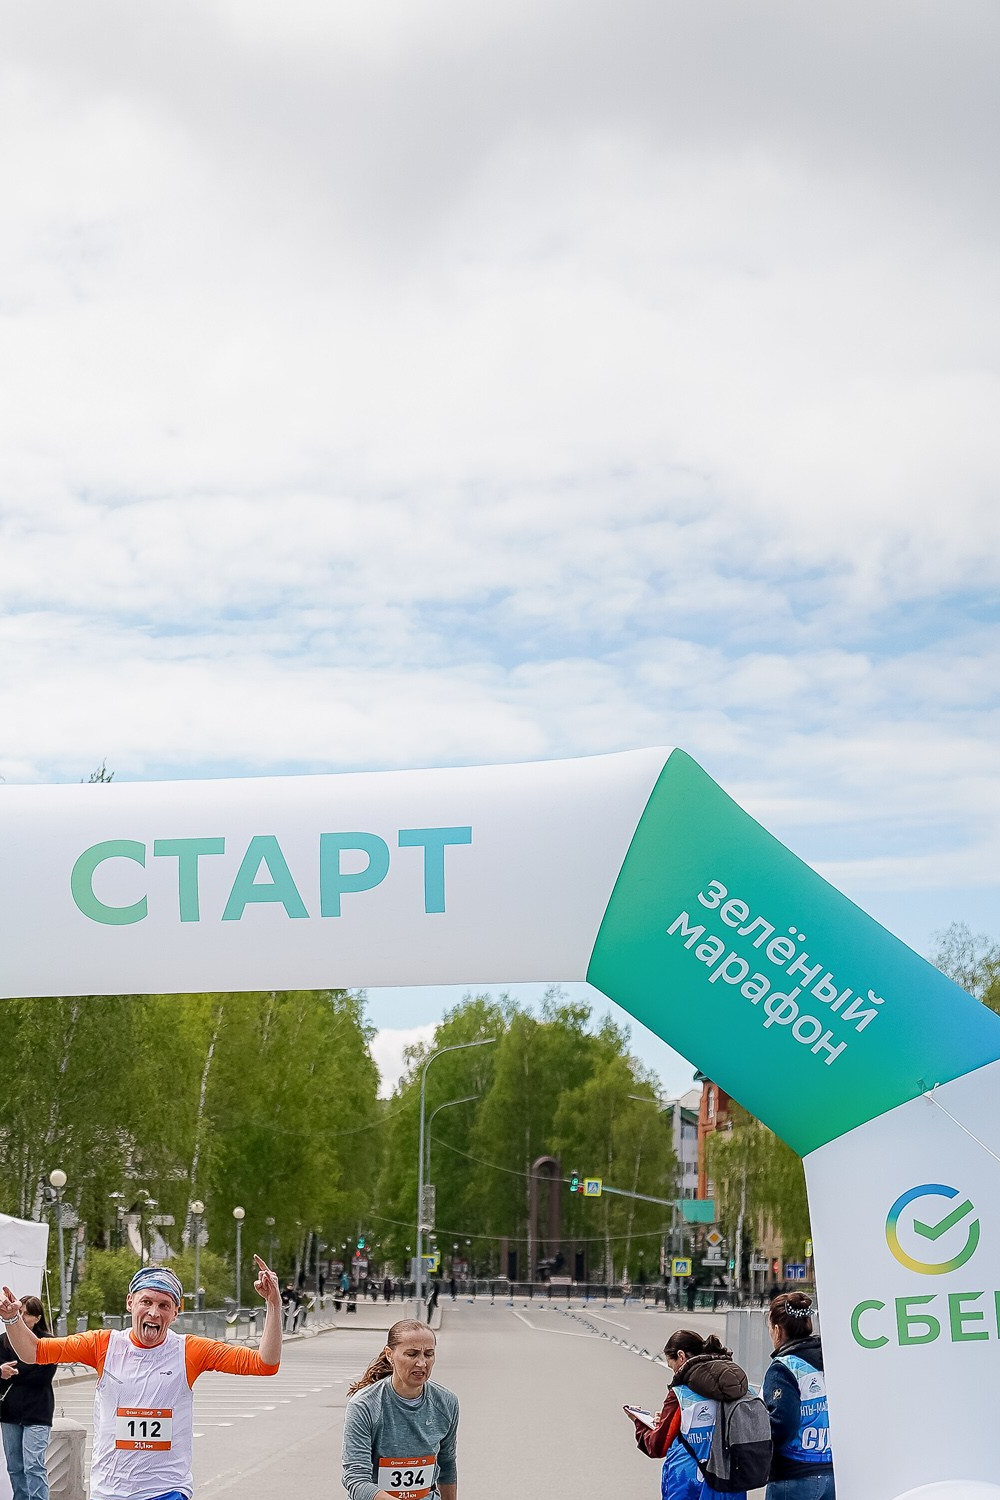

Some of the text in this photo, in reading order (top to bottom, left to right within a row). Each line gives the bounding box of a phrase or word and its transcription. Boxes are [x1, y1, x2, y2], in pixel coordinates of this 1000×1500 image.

[71, 826, 472, 926] СТАРТ
[666, 910, 848, 1066] марафон
[697, 879, 886, 1033] зелёный
[851, 1291, 1000, 1349] СБЕ
[127, 1420, 161, 1437] 112
[390, 1470, 425, 1487] 334
